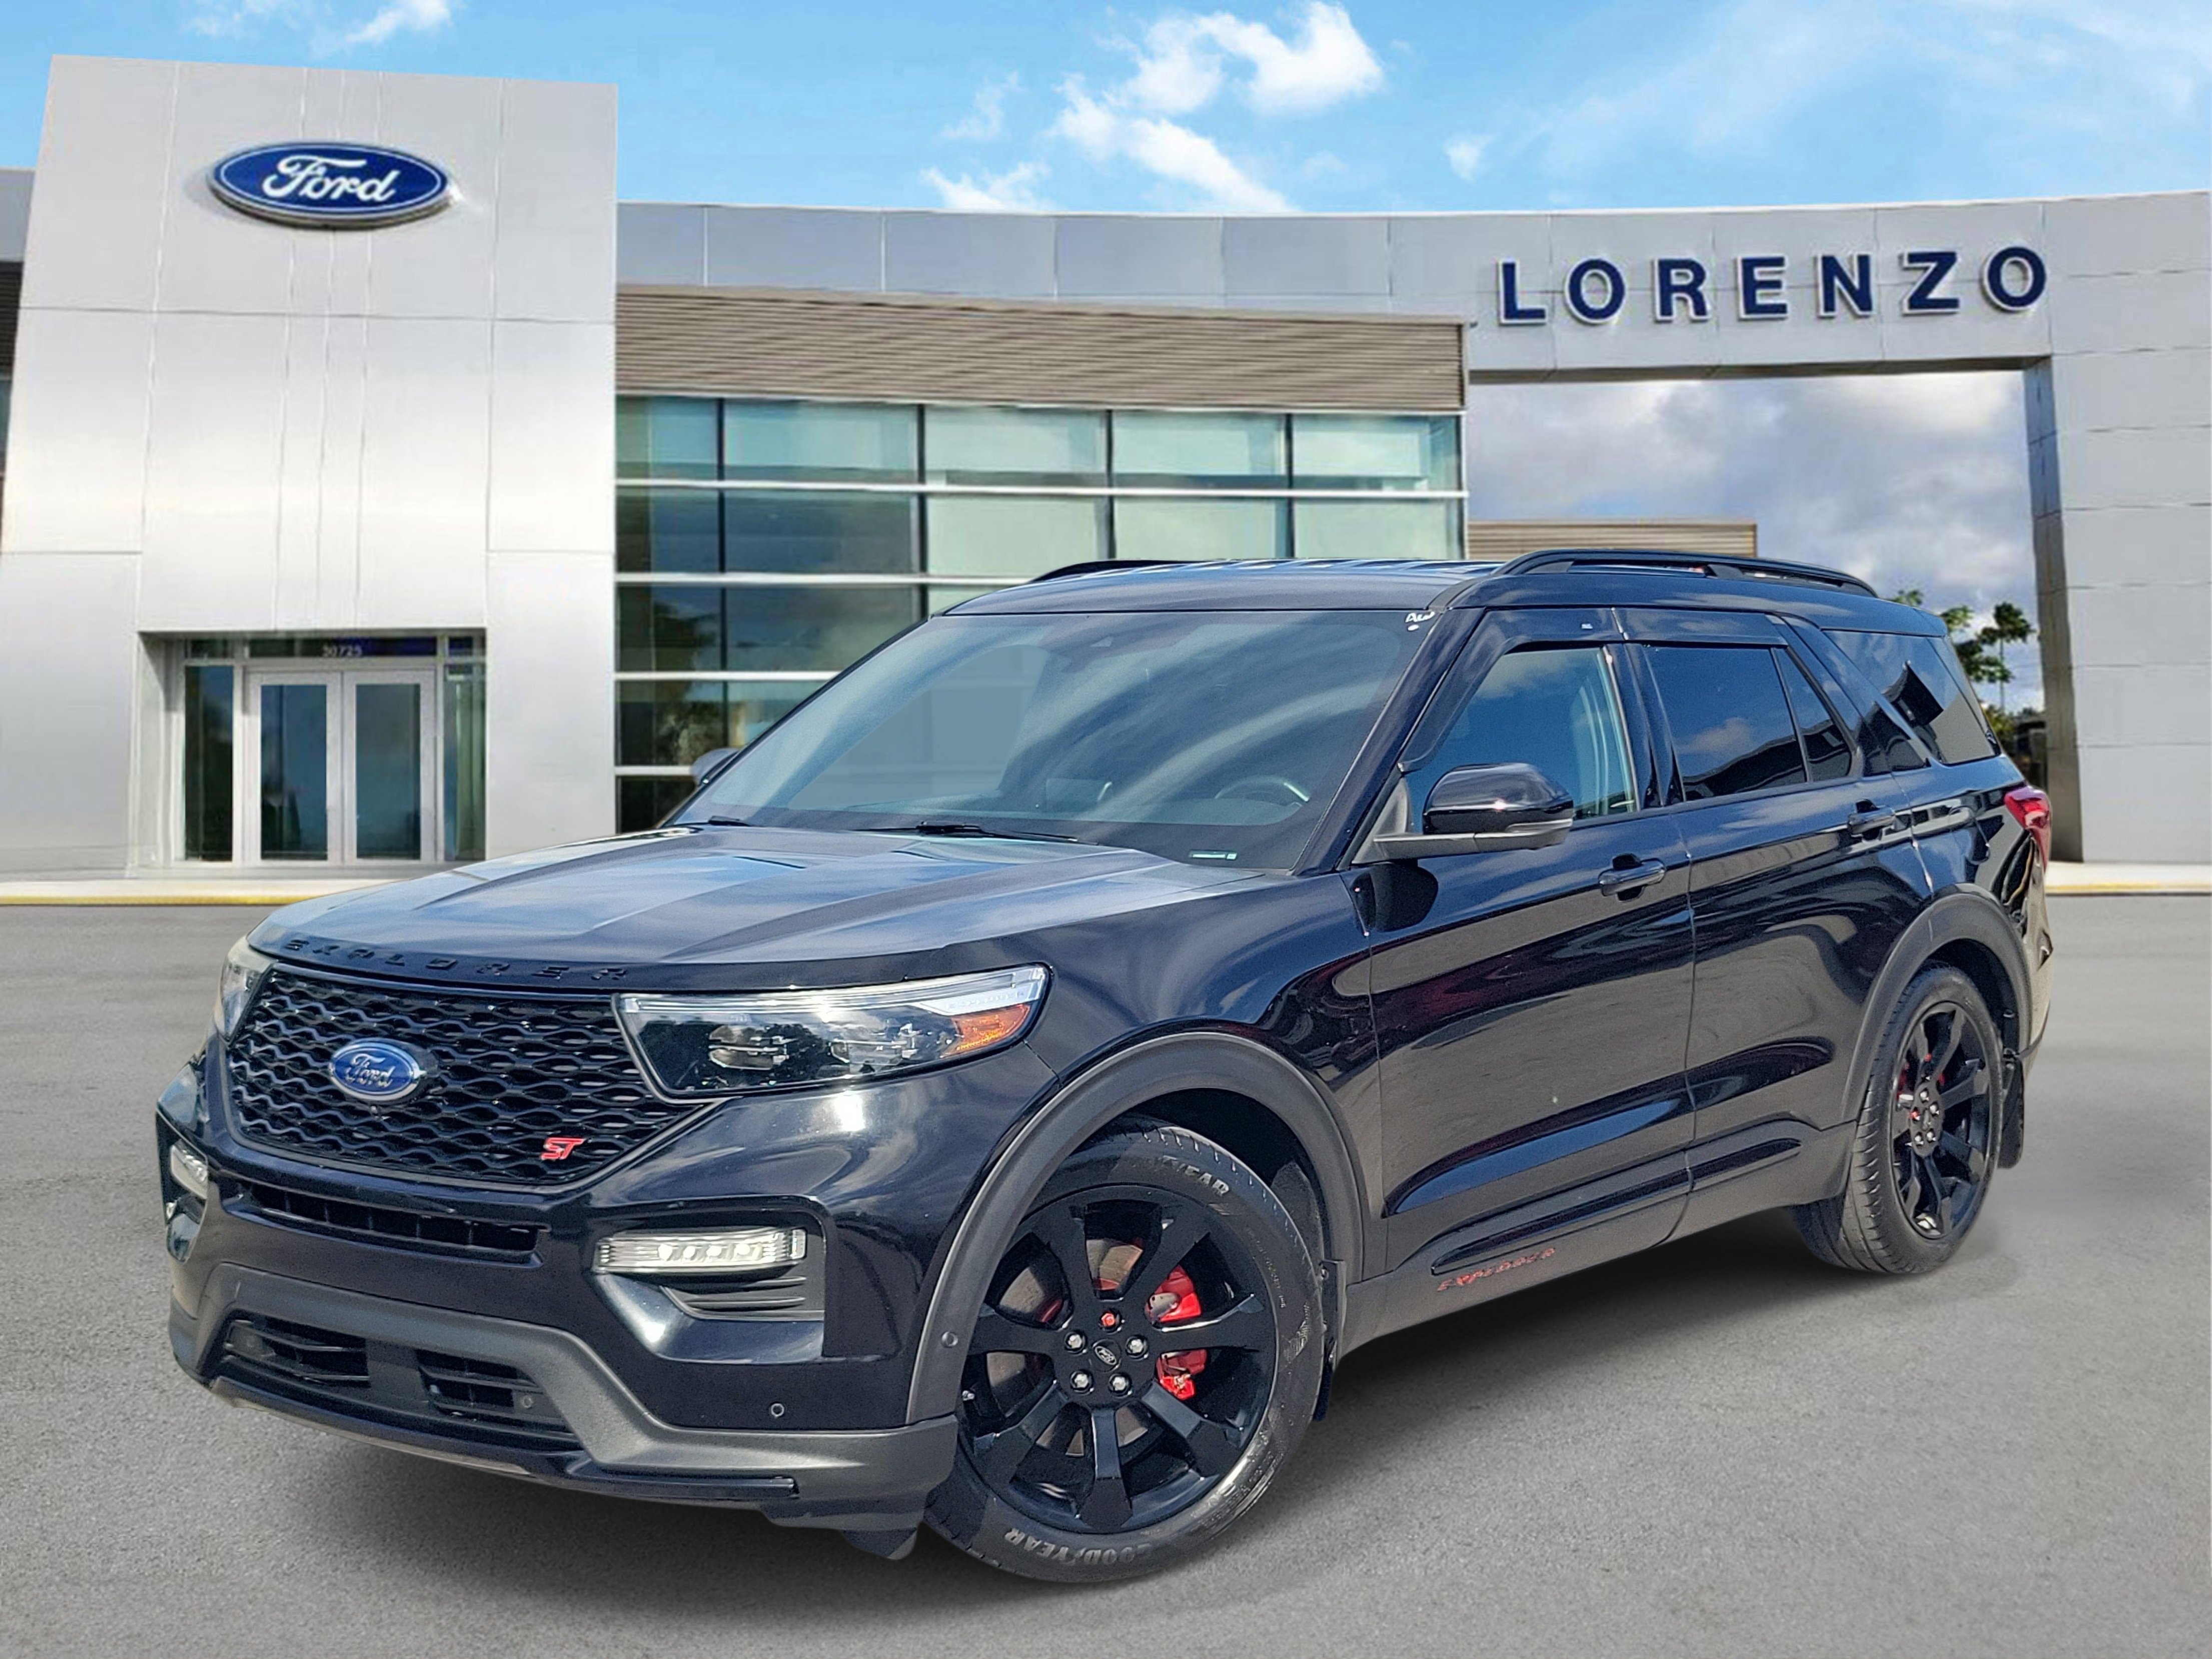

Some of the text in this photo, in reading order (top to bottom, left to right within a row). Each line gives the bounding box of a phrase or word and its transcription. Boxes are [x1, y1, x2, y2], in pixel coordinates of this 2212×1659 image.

[262, 154, 401, 202] Ford
[1496, 245, 2048, 325] LORENZO
[284, 939, 628, 981] EXPLORER
[345, 1053, 396, 1088] Ford
[539, 1137, 587, 1161] ST
